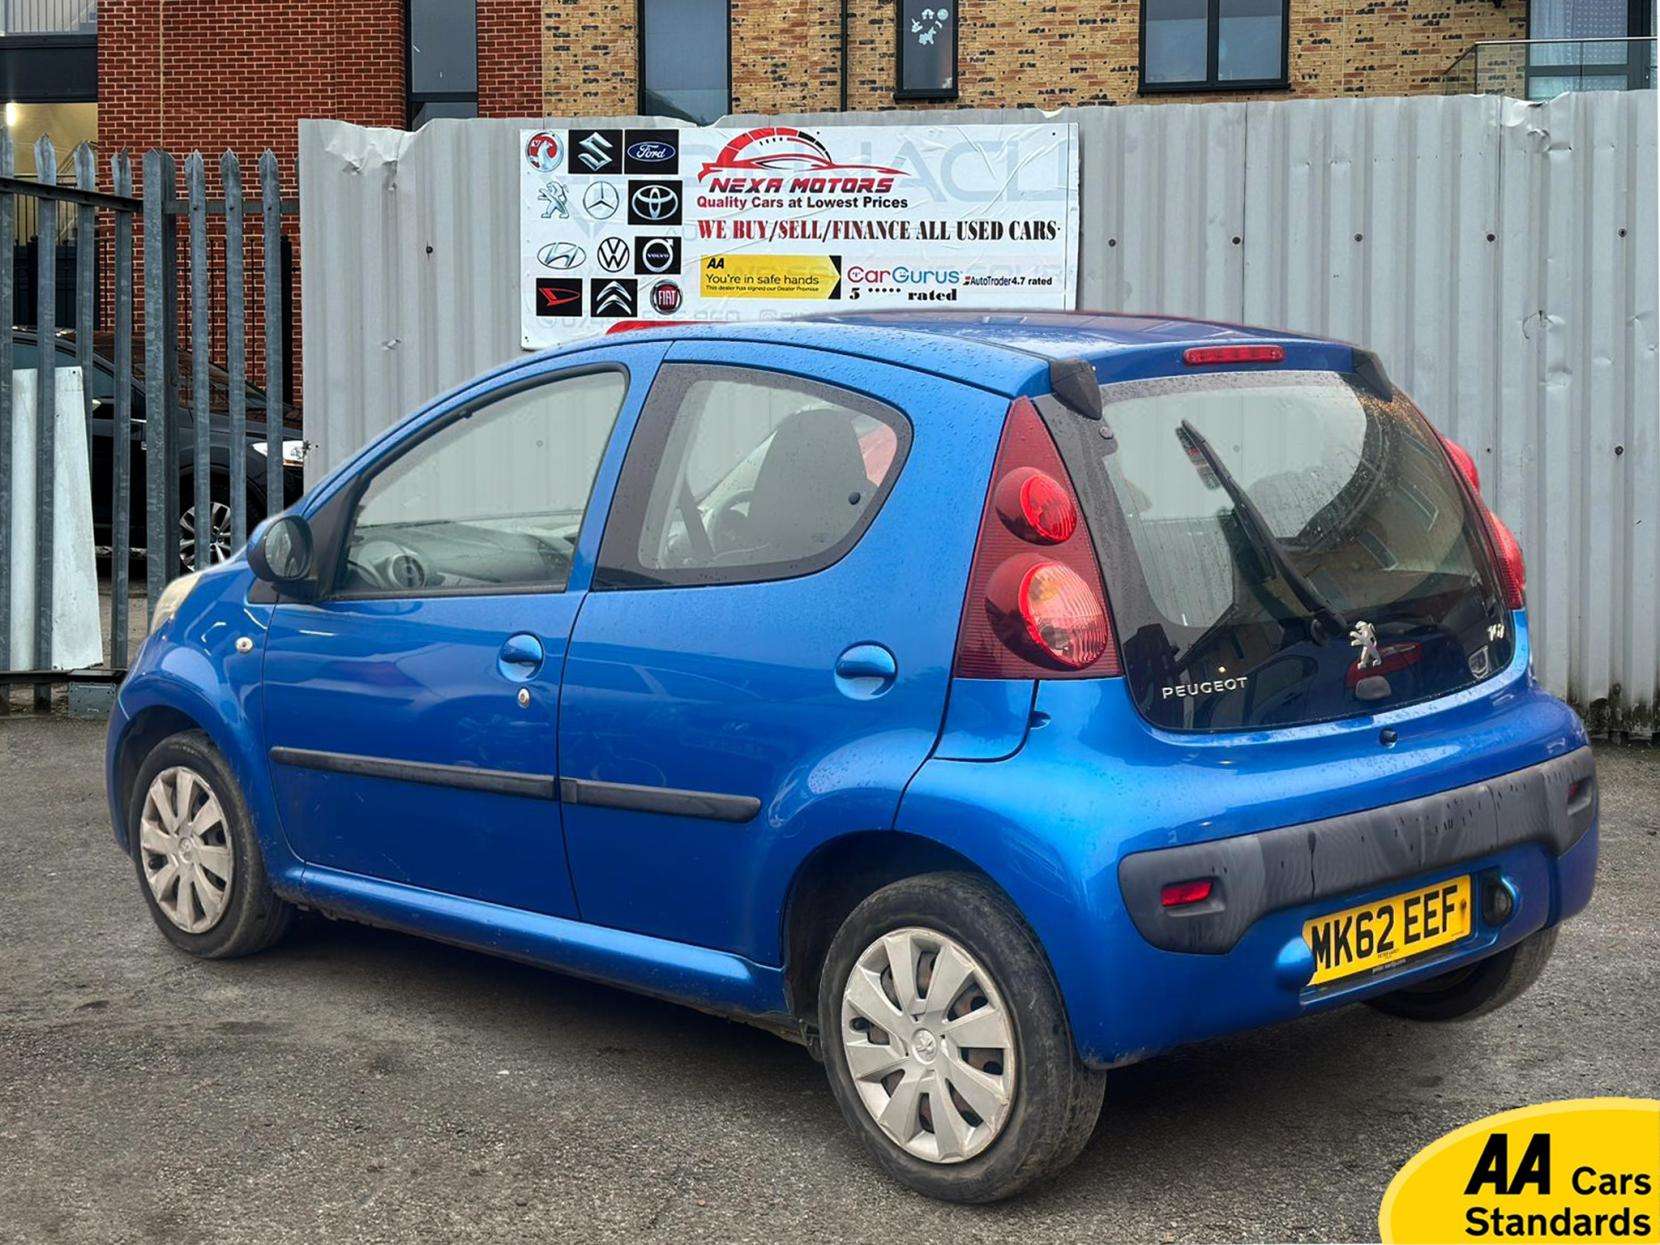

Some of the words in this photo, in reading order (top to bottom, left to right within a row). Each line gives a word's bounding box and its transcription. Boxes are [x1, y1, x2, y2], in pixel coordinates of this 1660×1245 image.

[637, 144, 666, 158] Ford
[709, 178, 781, 194] NEXA
[789, 178, 895, 194] MOTORS
[697, 196, 746, 210] Quality
[752, 196, 784, 208] Cars
[788, 196, 803, 208] at
[807, 196, 859, 208] Lowest
[863, 196, 908, 208] Prices
[697, 220, 727, 240] WE
[915, 220, 951, 241] ALL
[956, 220, 1004, 241] USED
[707, 257, 725, 269] AA
[744, 274, 755, 284] in
[757, 274, 781, 285] safe
[784, 274, 820, 286] hands
[848, 266, 960, 285] CarGurus
[1027, 276, 1053, 287] rated
[658, 290, 677, 306] FIAT
[849, 288, 861, 301] 5
[908, 288, 958, 302] rated
[1161, 677, 1249, 699] PEUGEOT
[1311, 904, 1395, 972] MK62
[1403, 884, 1458, 945] EEF
